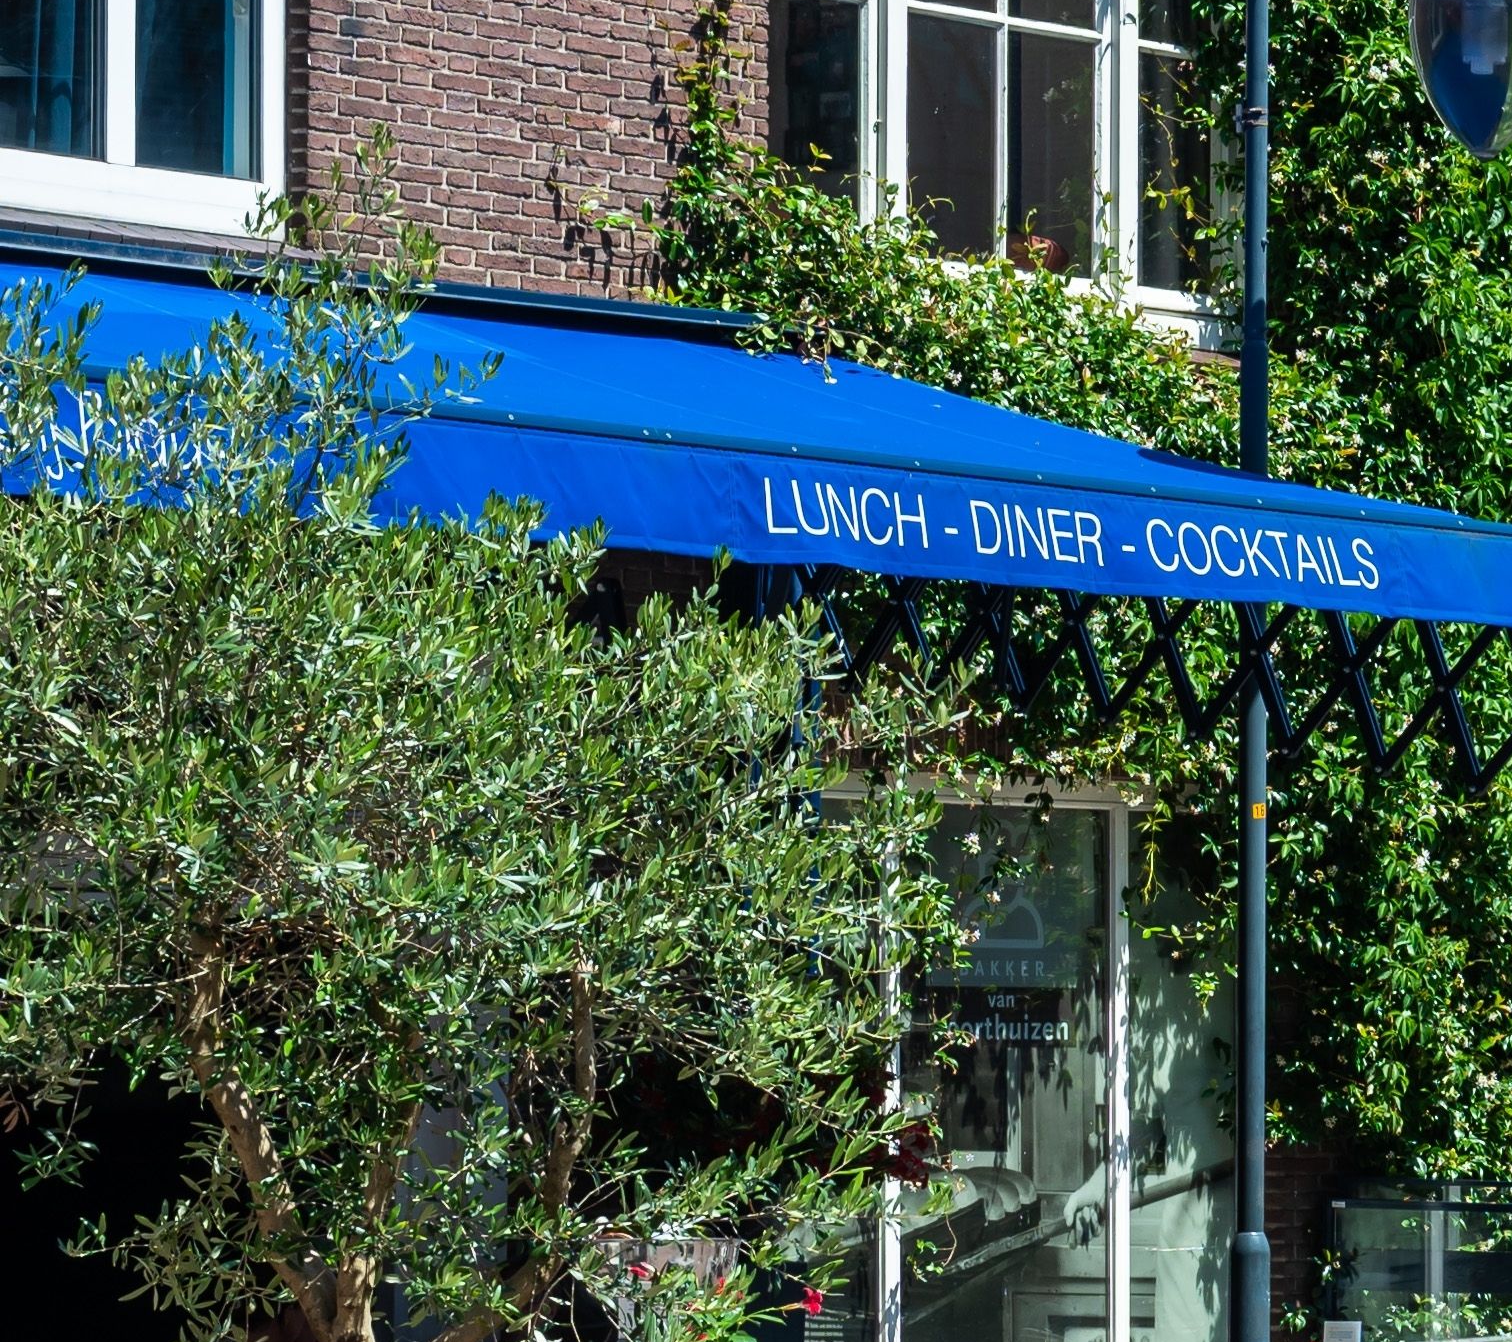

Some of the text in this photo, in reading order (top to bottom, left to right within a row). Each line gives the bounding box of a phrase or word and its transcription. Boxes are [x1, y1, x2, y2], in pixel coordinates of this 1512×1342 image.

[763, 476, 929, 549] LUNCH
[969, 499, 1105, 567] DINER
[1146, 517, 1381, 590] COCKTAILS
[988, 994, 1015, 1008] van
[946, 1013, 1069, 1041] oorthuizen
